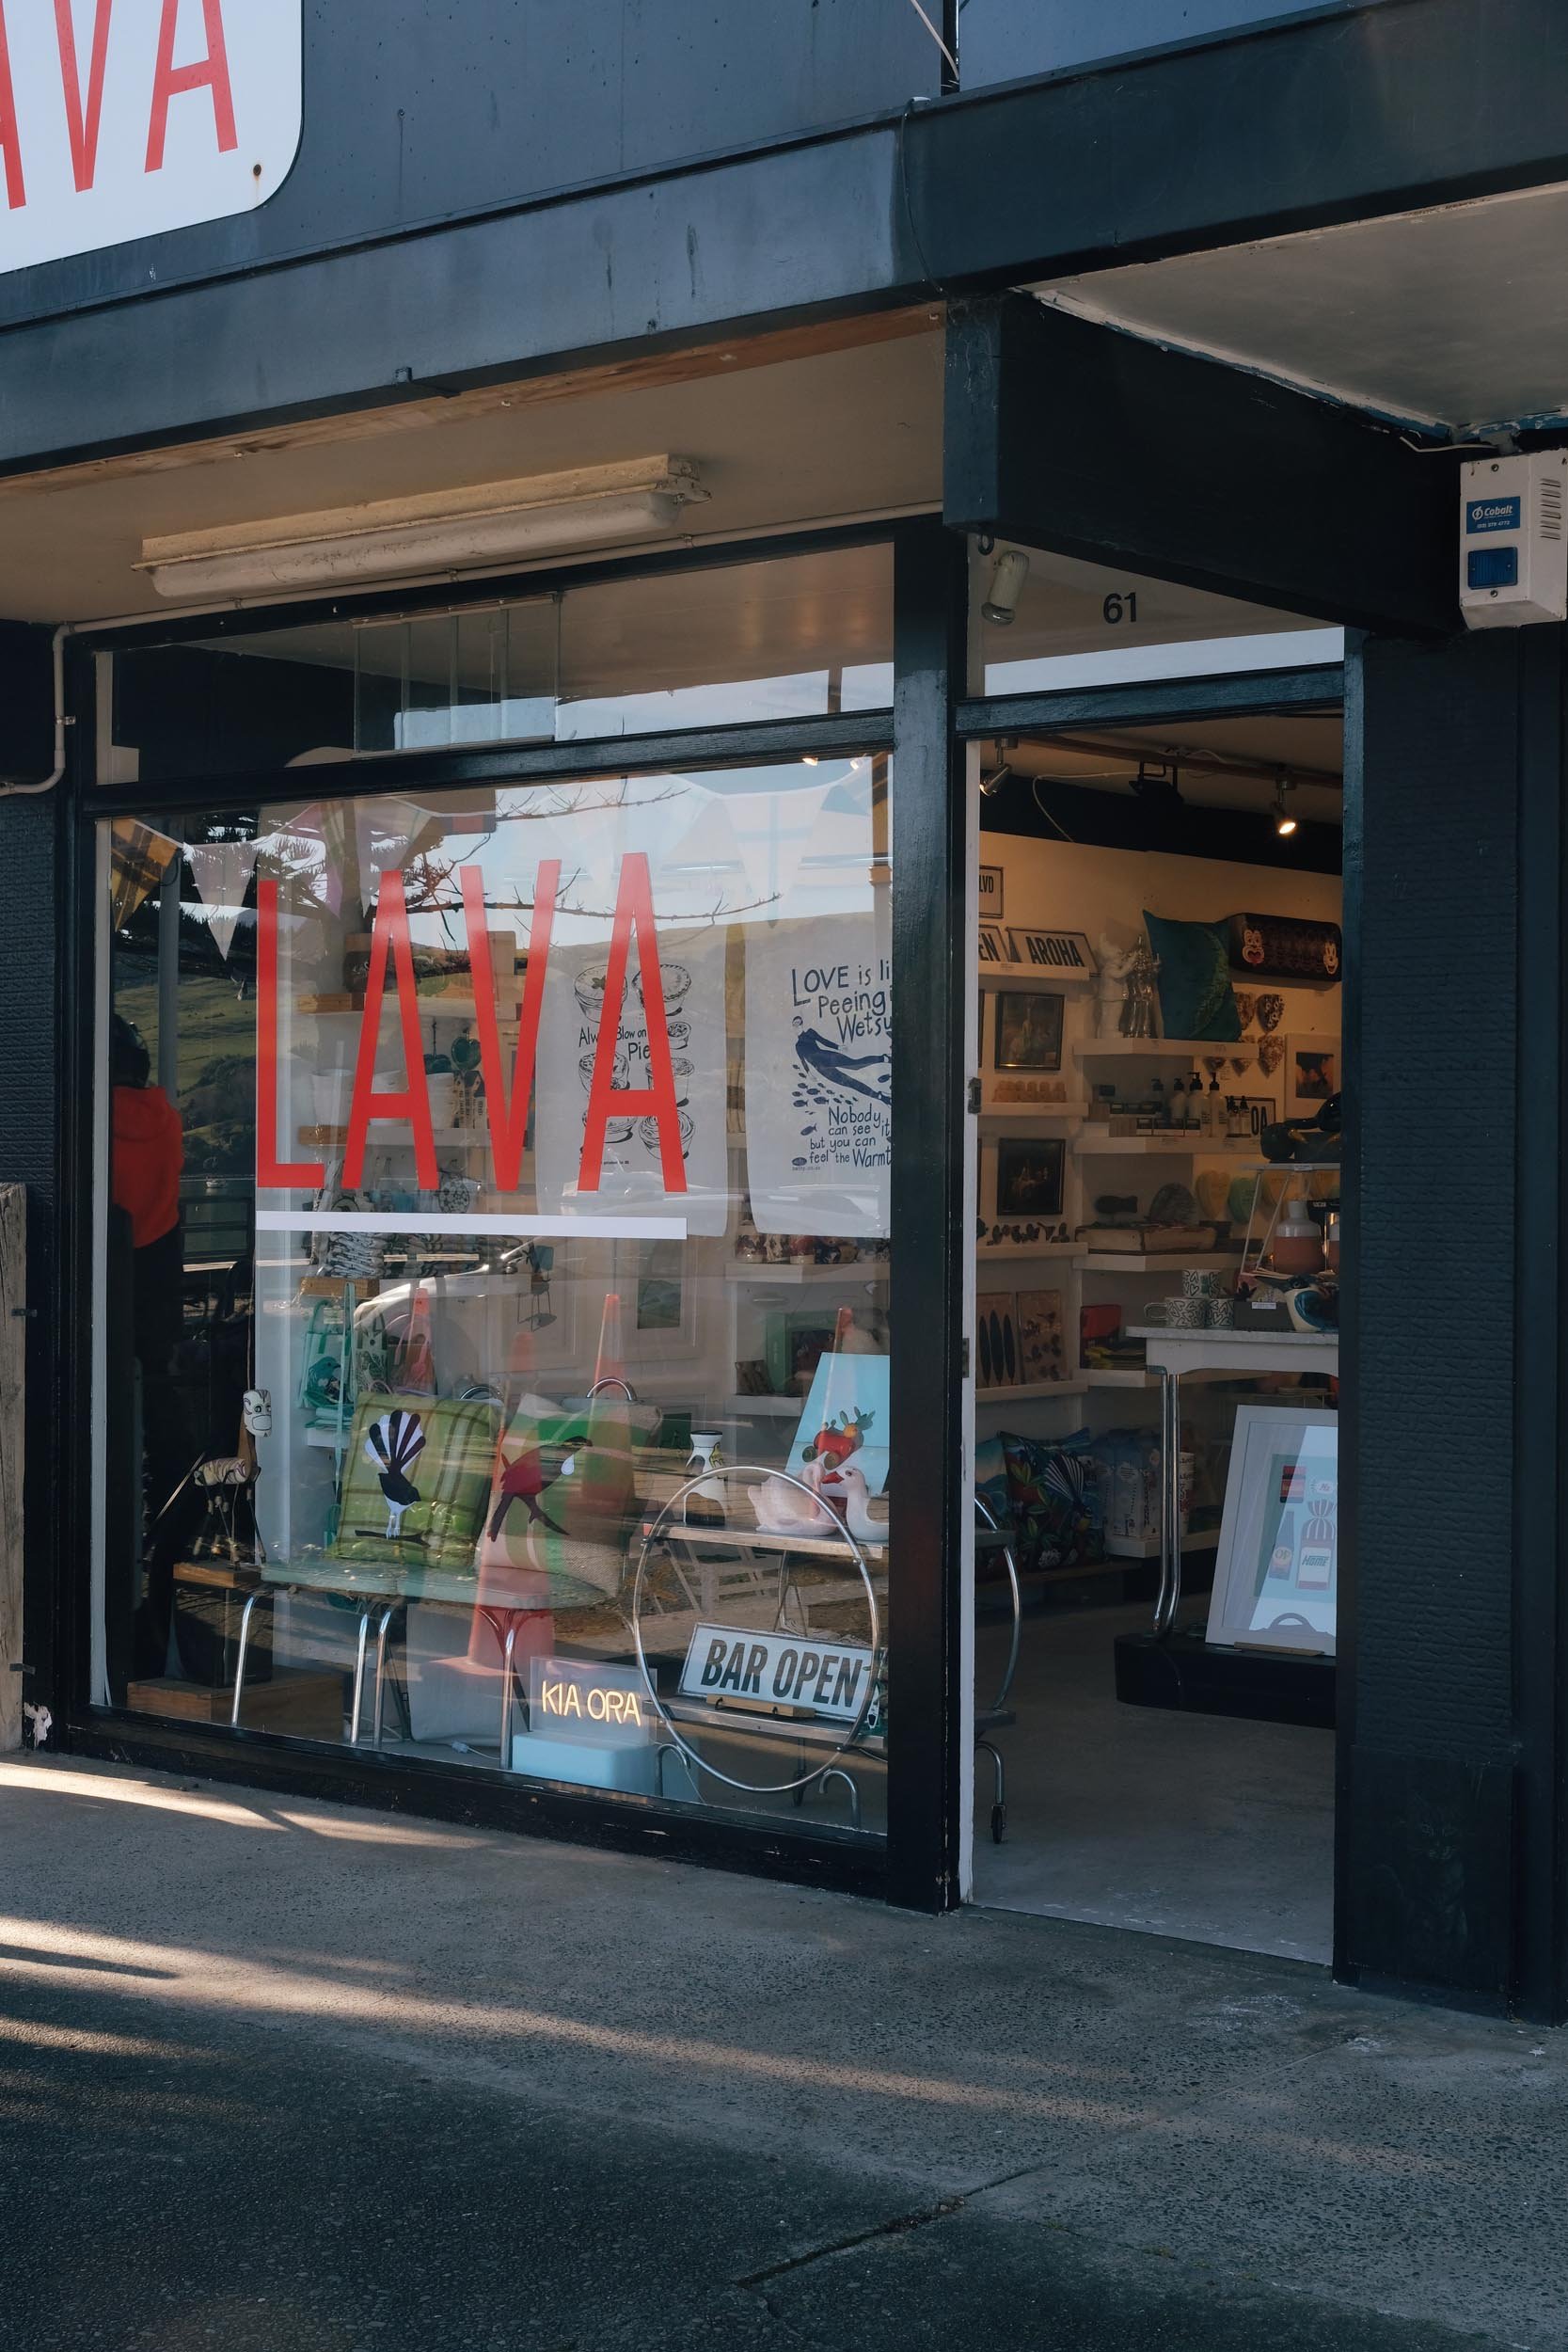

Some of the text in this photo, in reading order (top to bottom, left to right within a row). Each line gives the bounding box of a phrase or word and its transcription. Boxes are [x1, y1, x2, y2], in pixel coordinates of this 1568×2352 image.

[1484, 504, 1513, 516] Cobalt
[1103, 592, 1136, 624] 61
[979, 875, 994, 893] LVD
[1025, 936, 1085, 967] AROHA
[792, 959, 890, 1007] LOVE is li
[818, 991, 886, 1018] Peeing
[257, 852, 688, 1192] LAVA
[836, 1011, 892, 1043] Wetsu
[578, 1026, 598, 1047] Alw
[638, 1028, 647, 1039] on
[828, 1103, 881, 1129] Nobody
[829, 1118, 890, 1137] can see it
[809, 1146, 892, 1168] feel the Warmt
[810, 1136, 876, 1153] but you can
[701, 1639, 863, 1708] BAR OPEN
[542, 1680, 641, 1726] KIA ORA
